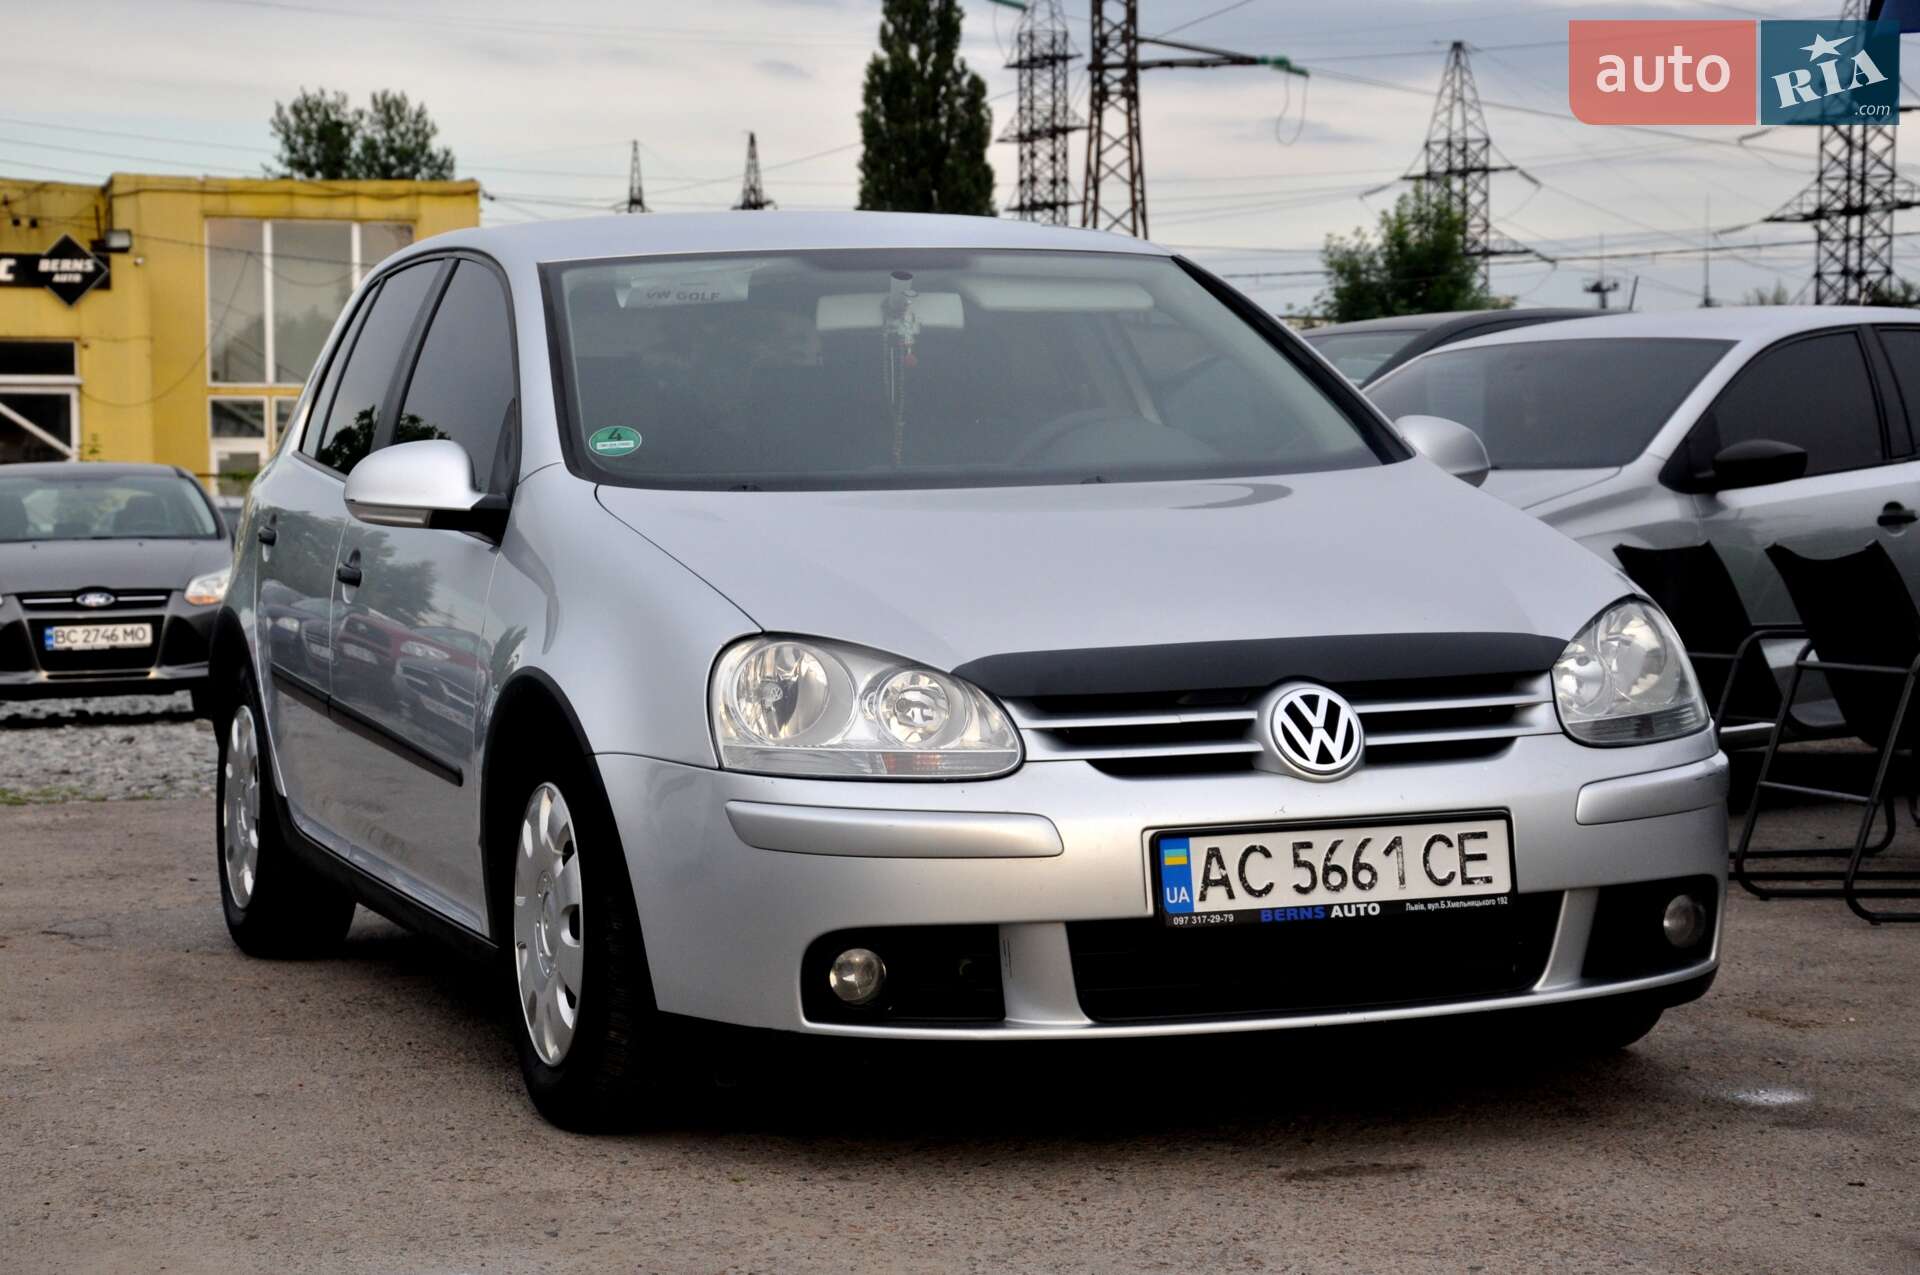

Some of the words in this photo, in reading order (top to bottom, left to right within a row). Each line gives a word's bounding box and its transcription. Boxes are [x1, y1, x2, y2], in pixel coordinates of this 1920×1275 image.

[38, 258, 95, 272] BERNS
[52, 273, 82, 283] AUTO
[676, 291, 720, 301] GOLF
[608, 428, 622, 440] 4
[54, 629, 78, 644] BC
[82, 627, 119, 643] 2746
[123, 626, 146, 641] MO
[1198, 844, 1274, 902] AC
[1292, 835, 1407, 895] 5661
[1422, 831, 1493, 887] CE
[1166, 887, 1190, 904] UA
[1497, 896, 1508, 905] 192
[1173, 916, 1188, 925] 097
[1191, 913, 1234, 924] 317-29-79
[1260, 906, 1325, 923] BERNS
[1330, 903, 1381, 918] AUTO
